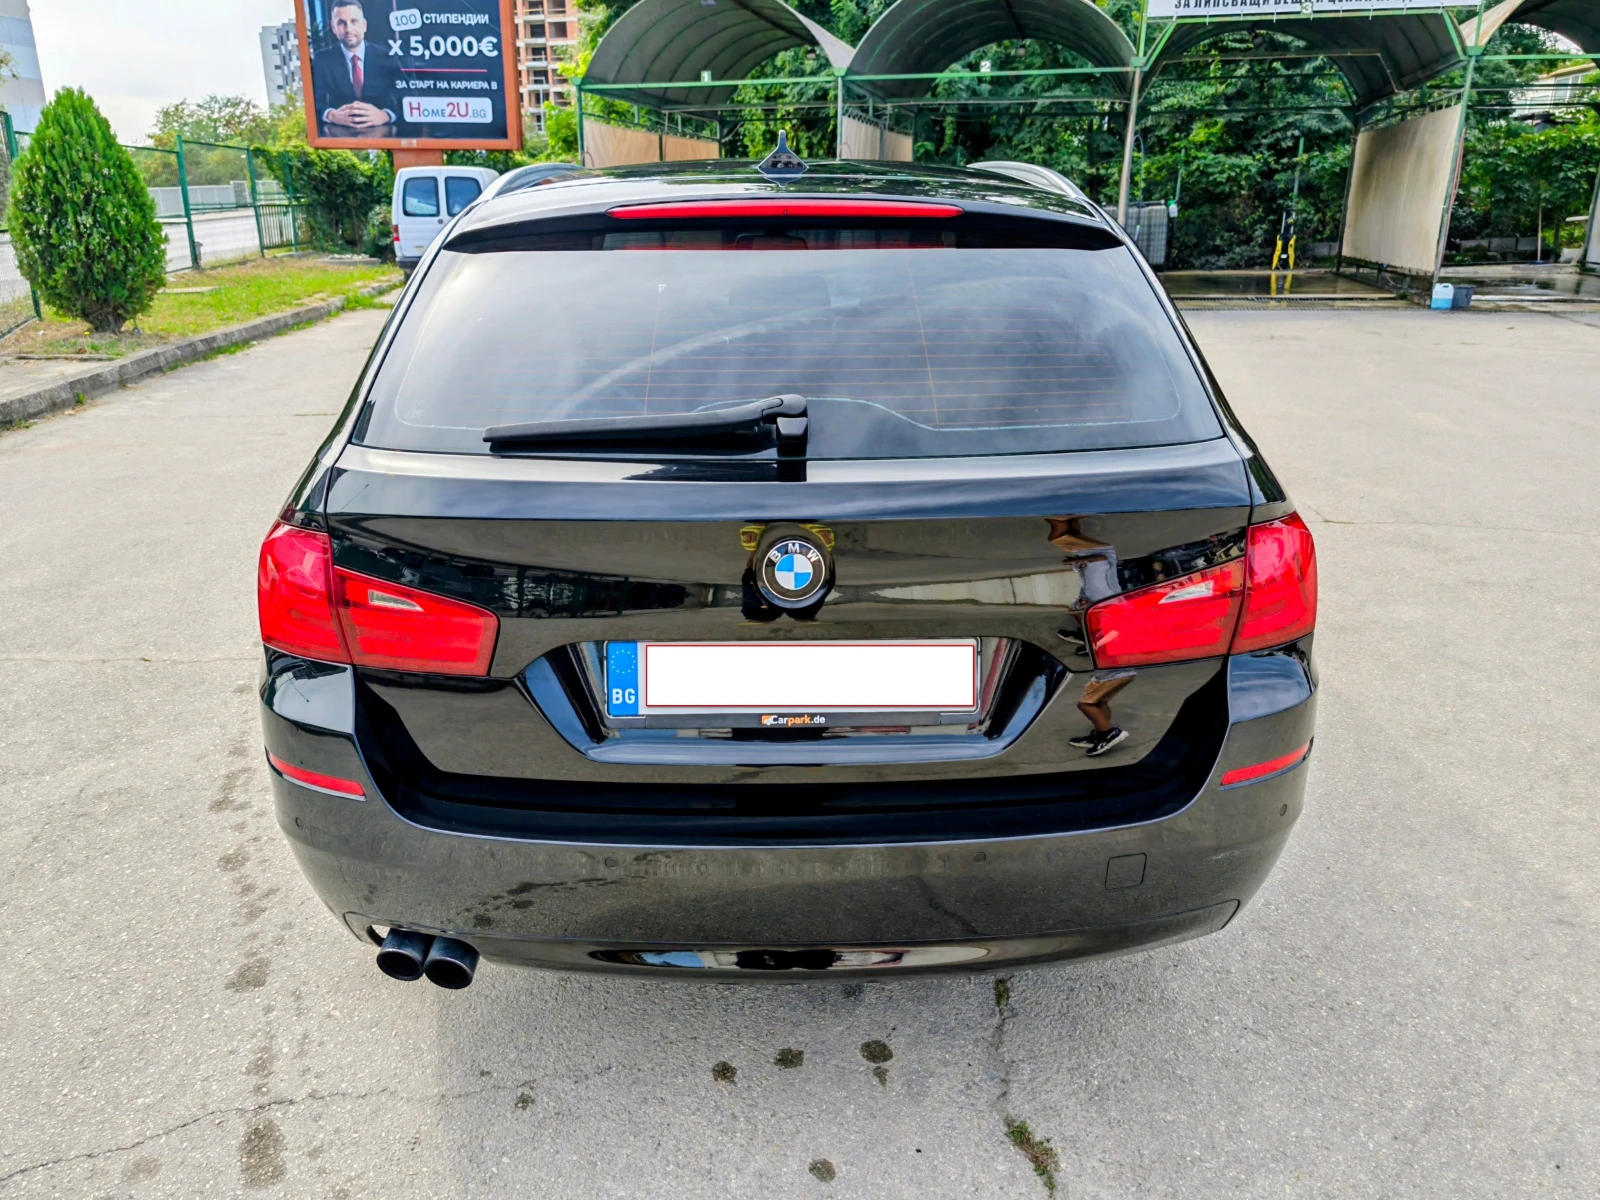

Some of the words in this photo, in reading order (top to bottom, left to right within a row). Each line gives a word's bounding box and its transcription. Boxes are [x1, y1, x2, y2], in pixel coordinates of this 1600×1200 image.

[1302, 2, 1313, 14] 3
[395, 14, 418, 26] 100
[423, 13, 490, 26] СТИПЕНДИИ
[409, 35, 499, 60] 5,000€
[980, 61, 991, 73] 2
[395, 80, 408, 89] ЗА
[409, 80, 435, 89] СТАРТ
[436, 80, 450, 89] НА
[451, 81, 490, 90] КАРИЕРА
[491, 81, 498, 90] В
[768, 543, 820, 563] BMW
[612, 688, 636, 704] BG
[771, 714, 826, 727] Carpark.de
